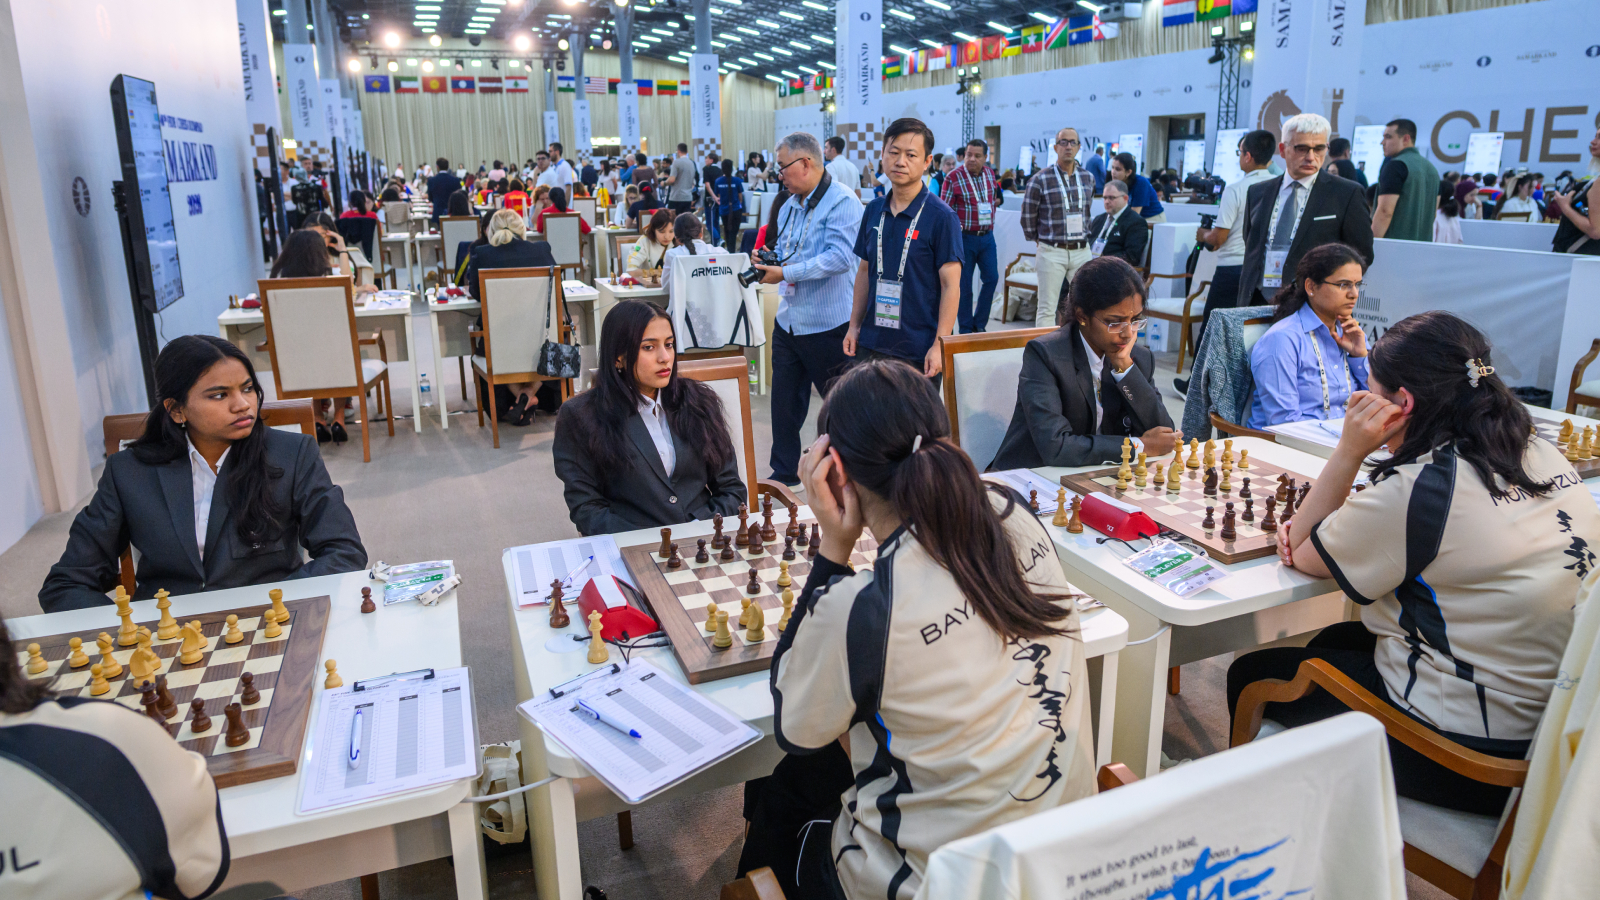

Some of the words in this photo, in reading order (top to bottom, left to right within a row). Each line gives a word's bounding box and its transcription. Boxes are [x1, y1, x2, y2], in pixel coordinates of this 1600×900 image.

[1276, 0, 1292, 48] SAM
[1331, 0, 1346, 47] SAM
[861, 43, 869, 106] SAMARKAND
[1431, 105, 1600, 164] CHE
[164, 139, 218, 183] MARKAND
[691, 266, 733, 278] ARMENIA
[1358, 313, 1388, 323] OLYMPIAD
[1489, 470, 1583, 506] MUNHZUL
[0, 847, 40, 874] L
[1080, 867, 1102, 882] was
[1106, 859, 1127, 874] too
[1129, 845, 1158, 869] good
[1160, 844, 1173, 857] to
